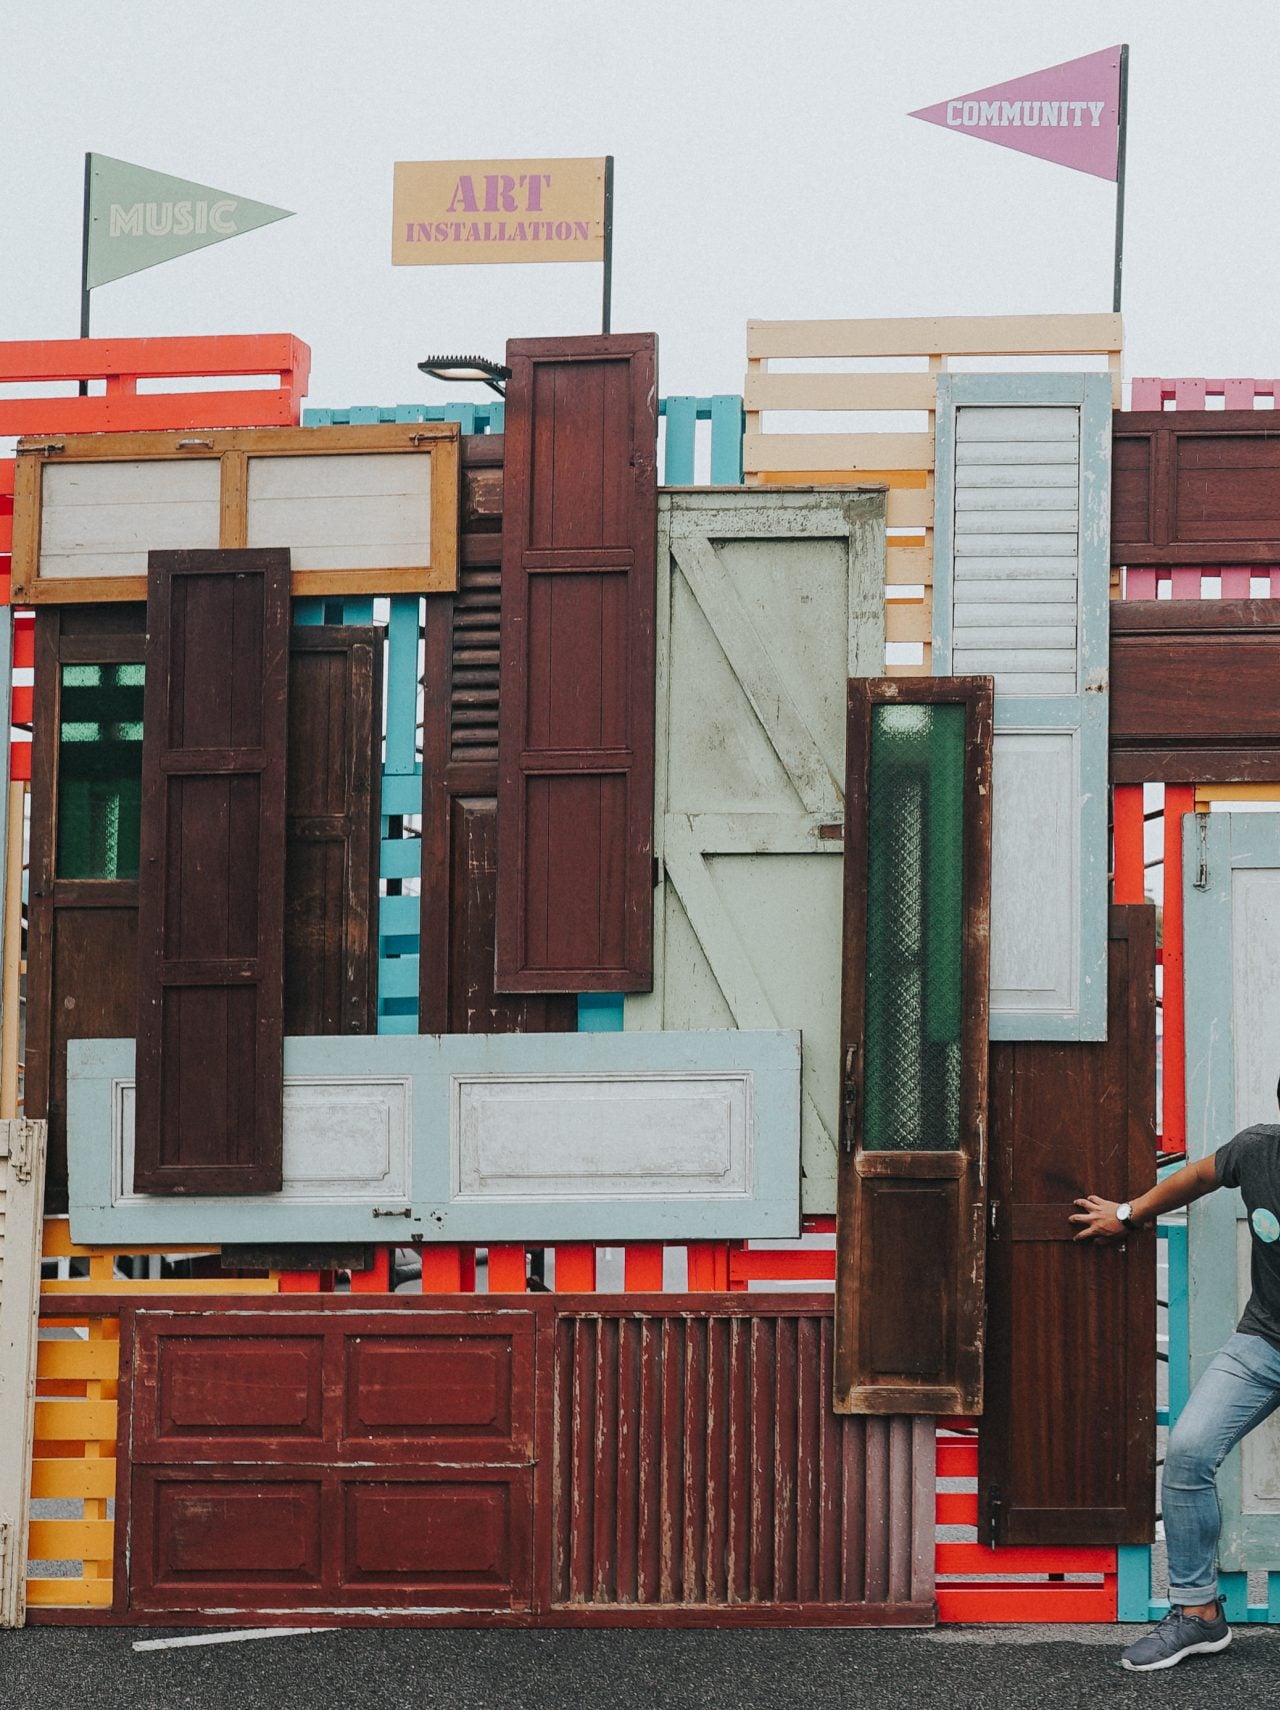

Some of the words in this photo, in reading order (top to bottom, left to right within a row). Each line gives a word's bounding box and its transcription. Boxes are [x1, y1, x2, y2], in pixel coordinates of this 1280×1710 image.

[945, 100, 1105, 129] COMMUNITY
[445, 174, 552, 214] ART
[108, 199, 239, 239] MUSIC
[404, 220, 591, 243] INSTALLATION
